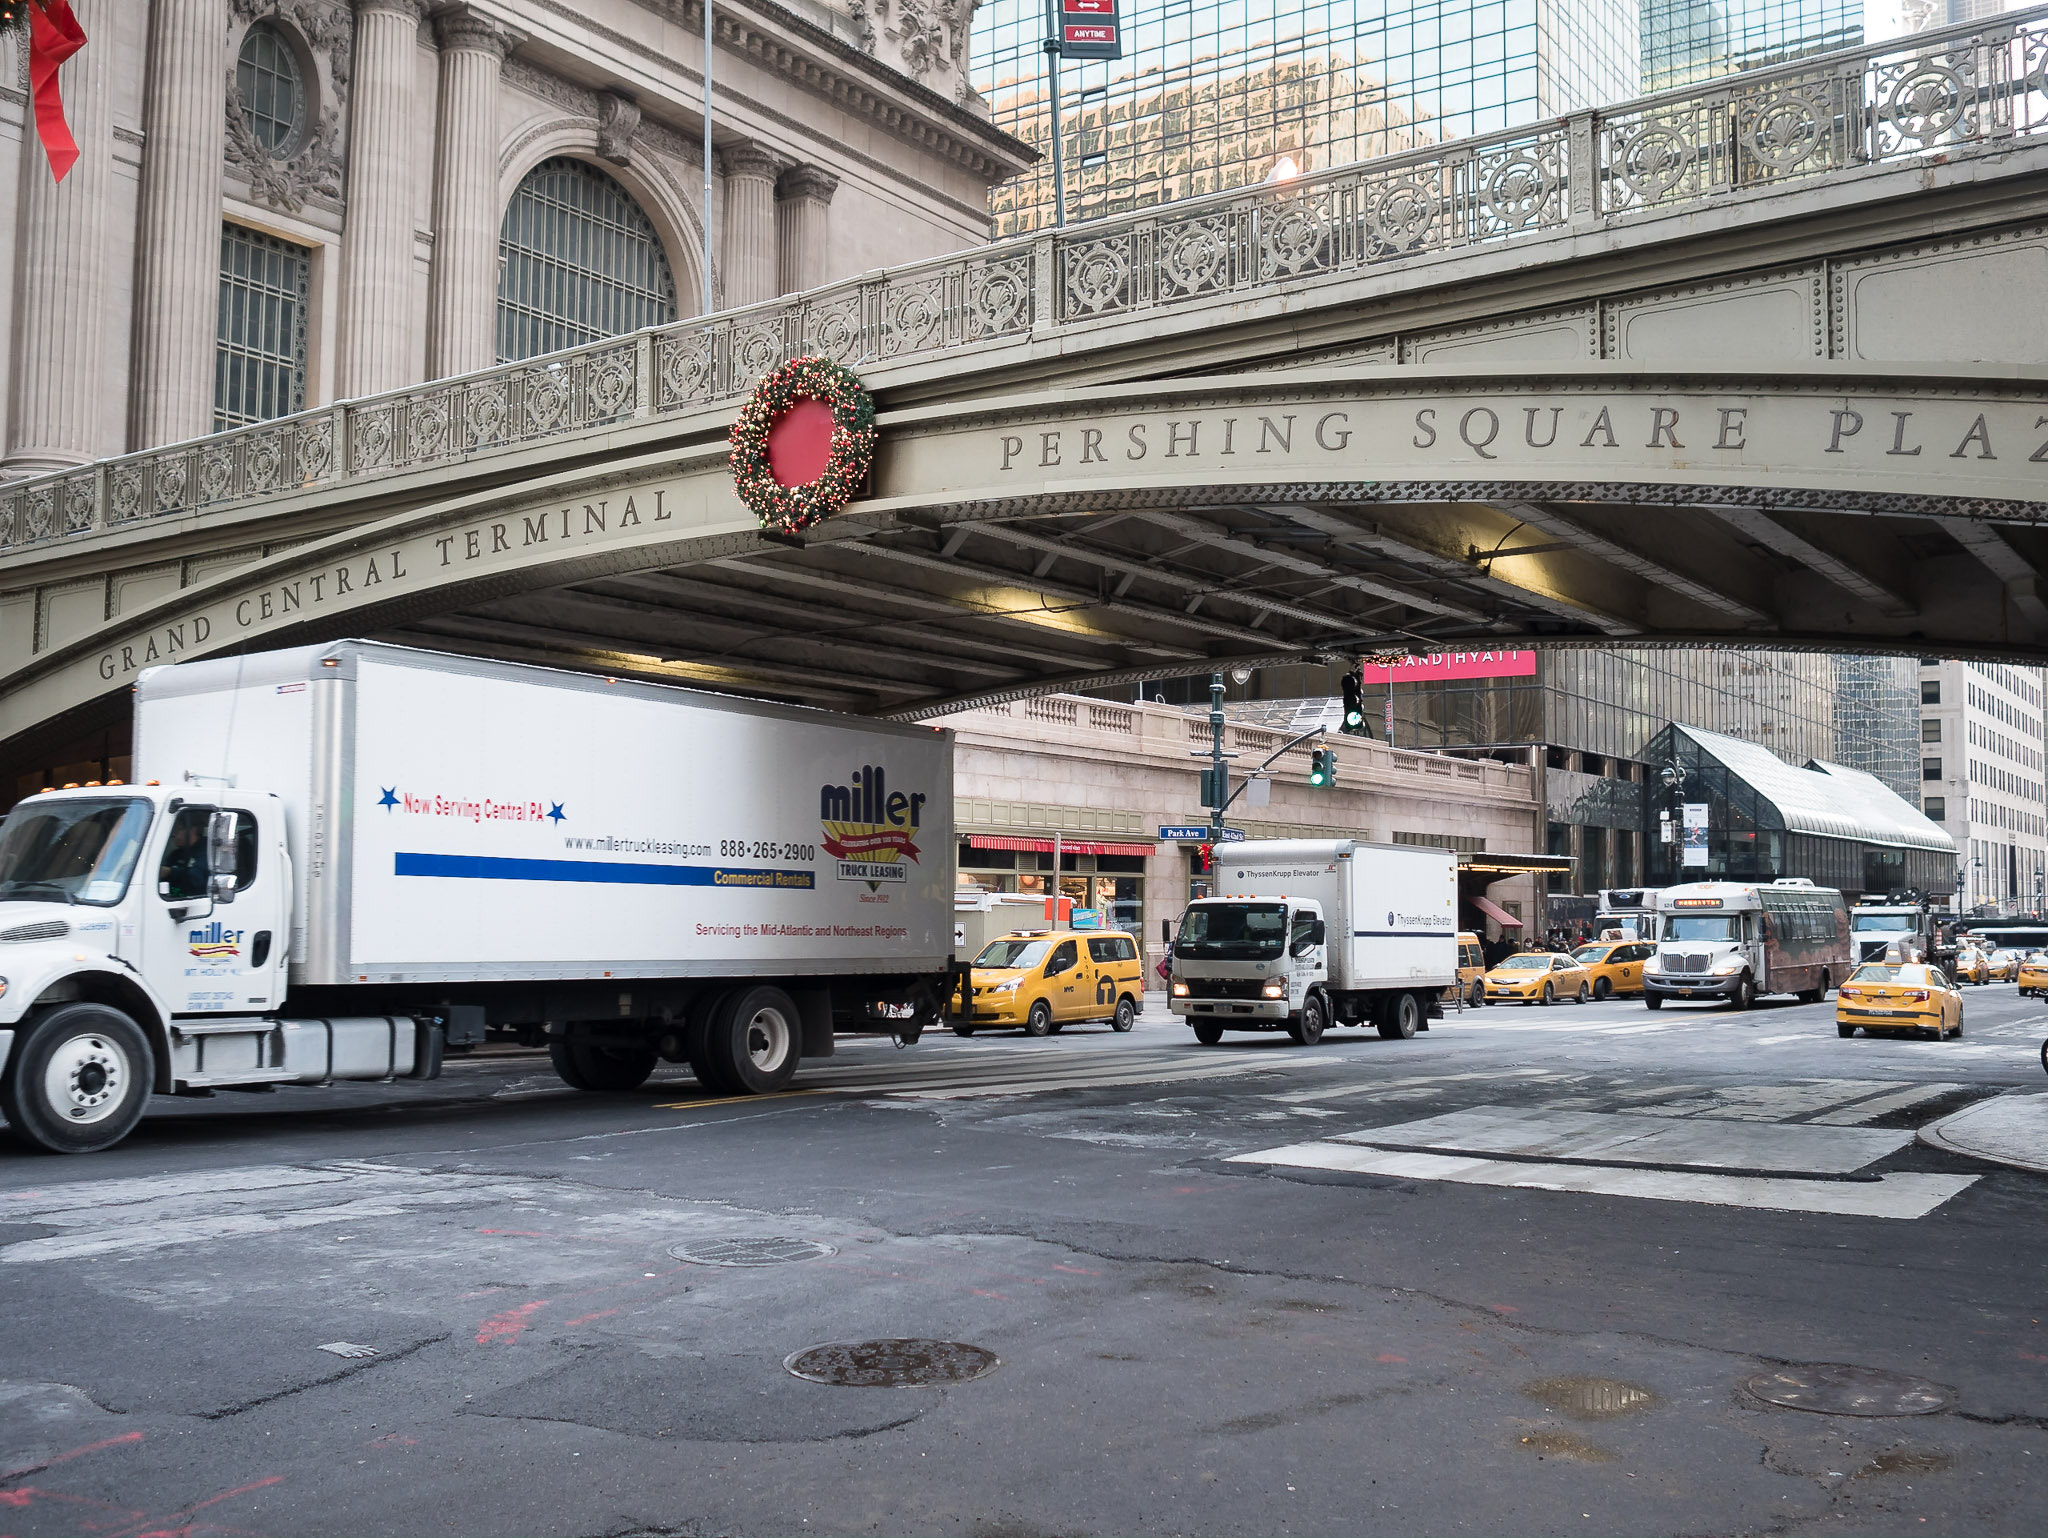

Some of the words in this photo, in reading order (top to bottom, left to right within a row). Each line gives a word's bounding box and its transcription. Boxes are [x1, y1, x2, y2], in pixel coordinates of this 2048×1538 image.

[1074, 30, 1106, 38] ANYTIME
[1000, 411, 1353, 470] PERSHING
[1413, 406, 1747, 459] SQUARE
[99, 615, 211, 681] GRAND
[236, 551, 407, 627] CENTRAL
[435, 490, 672, 567] TERMINAL
[820, 764, 926, 828] miller
[404, 793, 430, 814] Now
[435, 794, 480, 823] Serving
[484, 798, 526, 821] Central
[529, 802, 544, 822] PA
[1167, 829, 1184, 837] Park
[1185, 829, 1199, 837] Ave
[564, 836, 712, 859] www.millertruckleasing.com
[714, 870, 773, 886] Commercial
[776, 872, 811, 887] Rentals
[840, 864, 868, 877] TRUCK
[870, 865, 904, 879] LEASING
[1247, 870, 1291, 878] ThyssenKrupp
[1293, 869, 1319, 877] Elevator
[189, 921, 244, 943] miller
[695, 923, 741, 939] Servicing
[743, 924, 758, 936] the
[760, 923, 813, 936] Mid-Atlantic
[815, 925, 830, 936] and
[832, 925, 873, 937] Northeast
[874, 925, 907, 939] Regions
